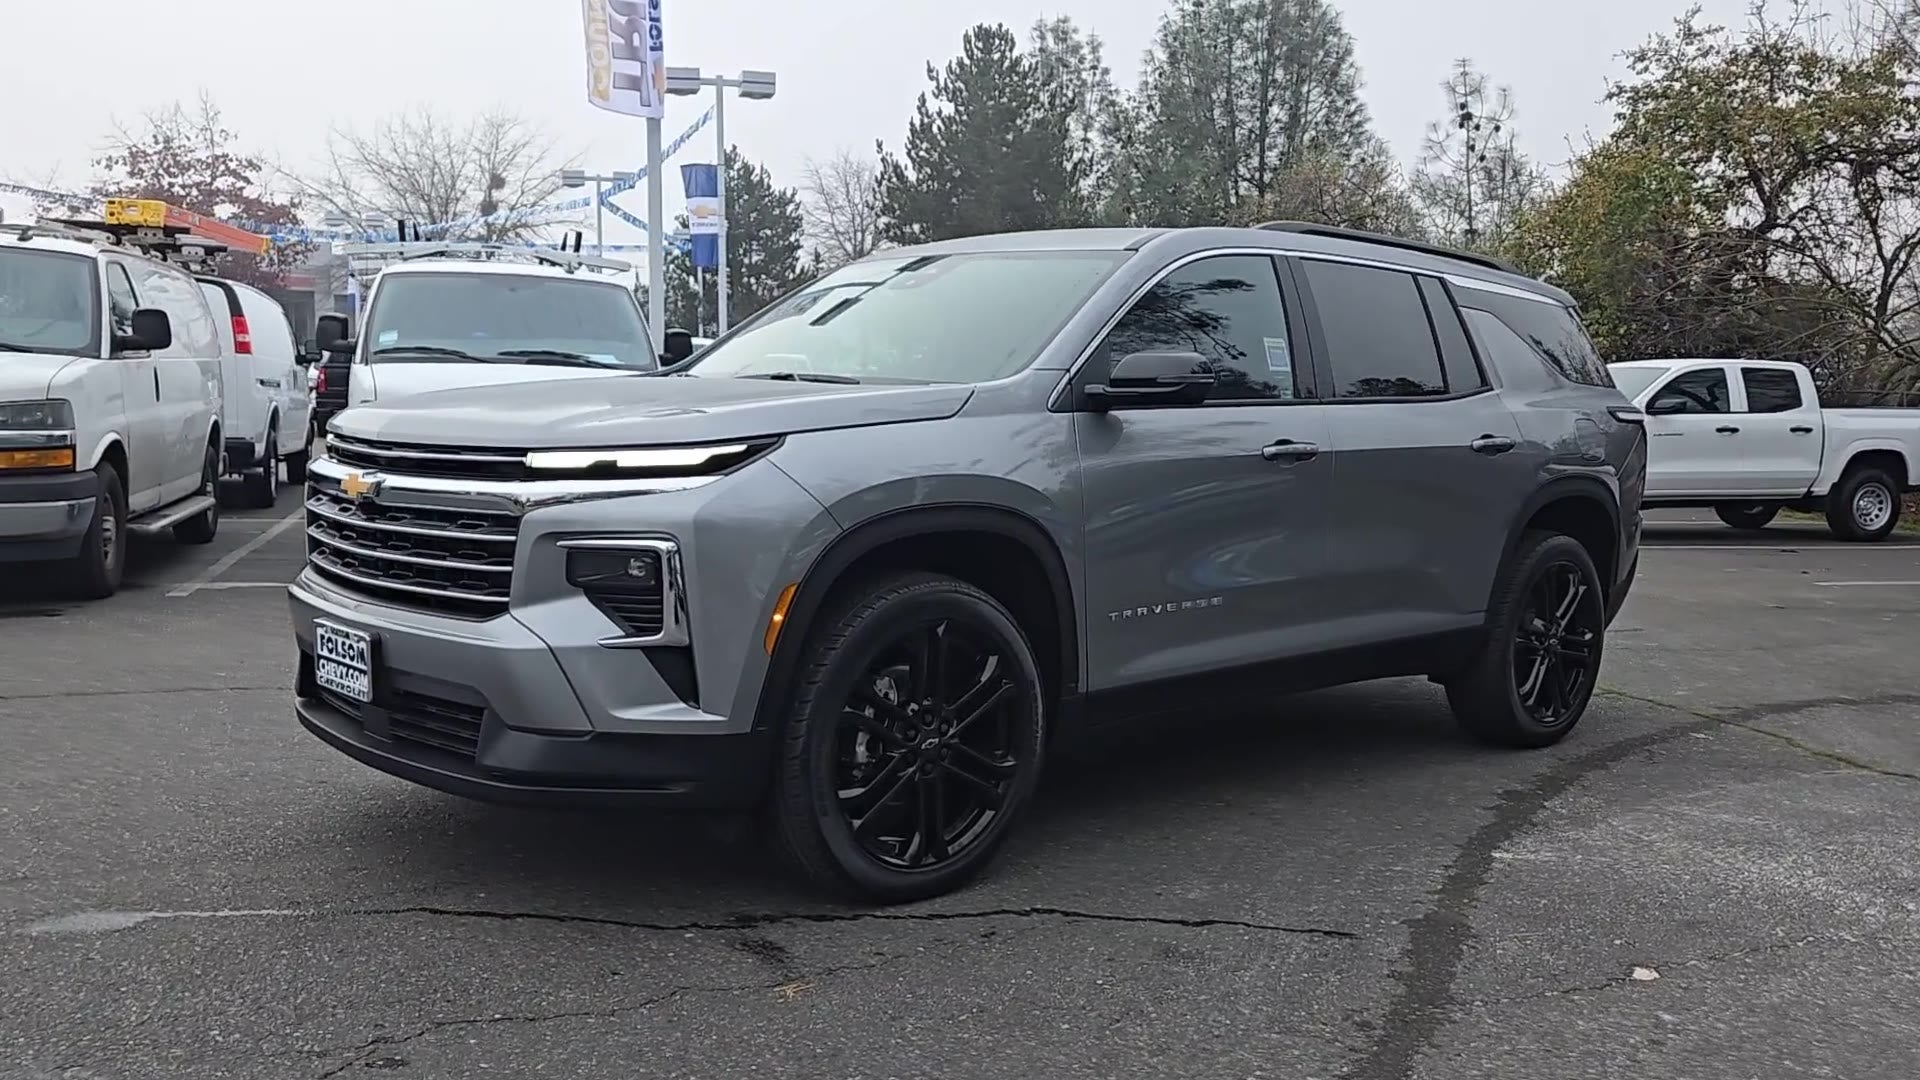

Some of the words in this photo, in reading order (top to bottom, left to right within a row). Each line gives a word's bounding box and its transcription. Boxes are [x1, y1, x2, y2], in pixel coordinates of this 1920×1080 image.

[1108, 597, 1223, 621] TRAVERSE
[319, 633, 367, 666] FOLSOM
[319, 658, 368, 687] CHEVY.COM
[319, 675, 368, 699] CHEVROLET
